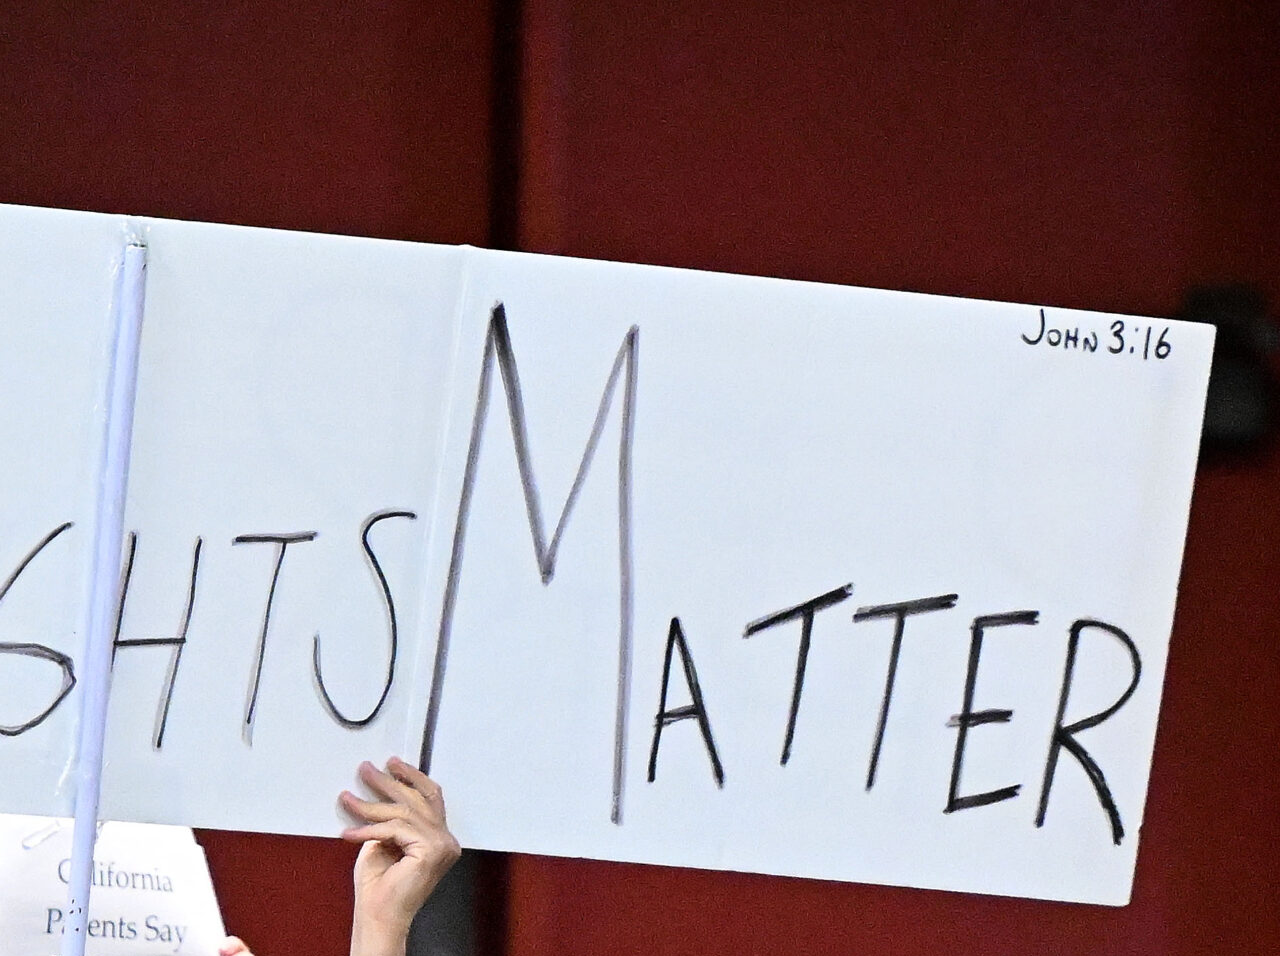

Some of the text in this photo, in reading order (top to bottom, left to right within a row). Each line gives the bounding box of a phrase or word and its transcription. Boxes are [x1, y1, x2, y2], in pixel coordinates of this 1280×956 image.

[1107, 320, 1171, 360] 3:16
[418, 301, 1143, 845] MATTER
[57, 858, 174, 893] Clifornia
[45, 907, 188, 952] Pents Say
